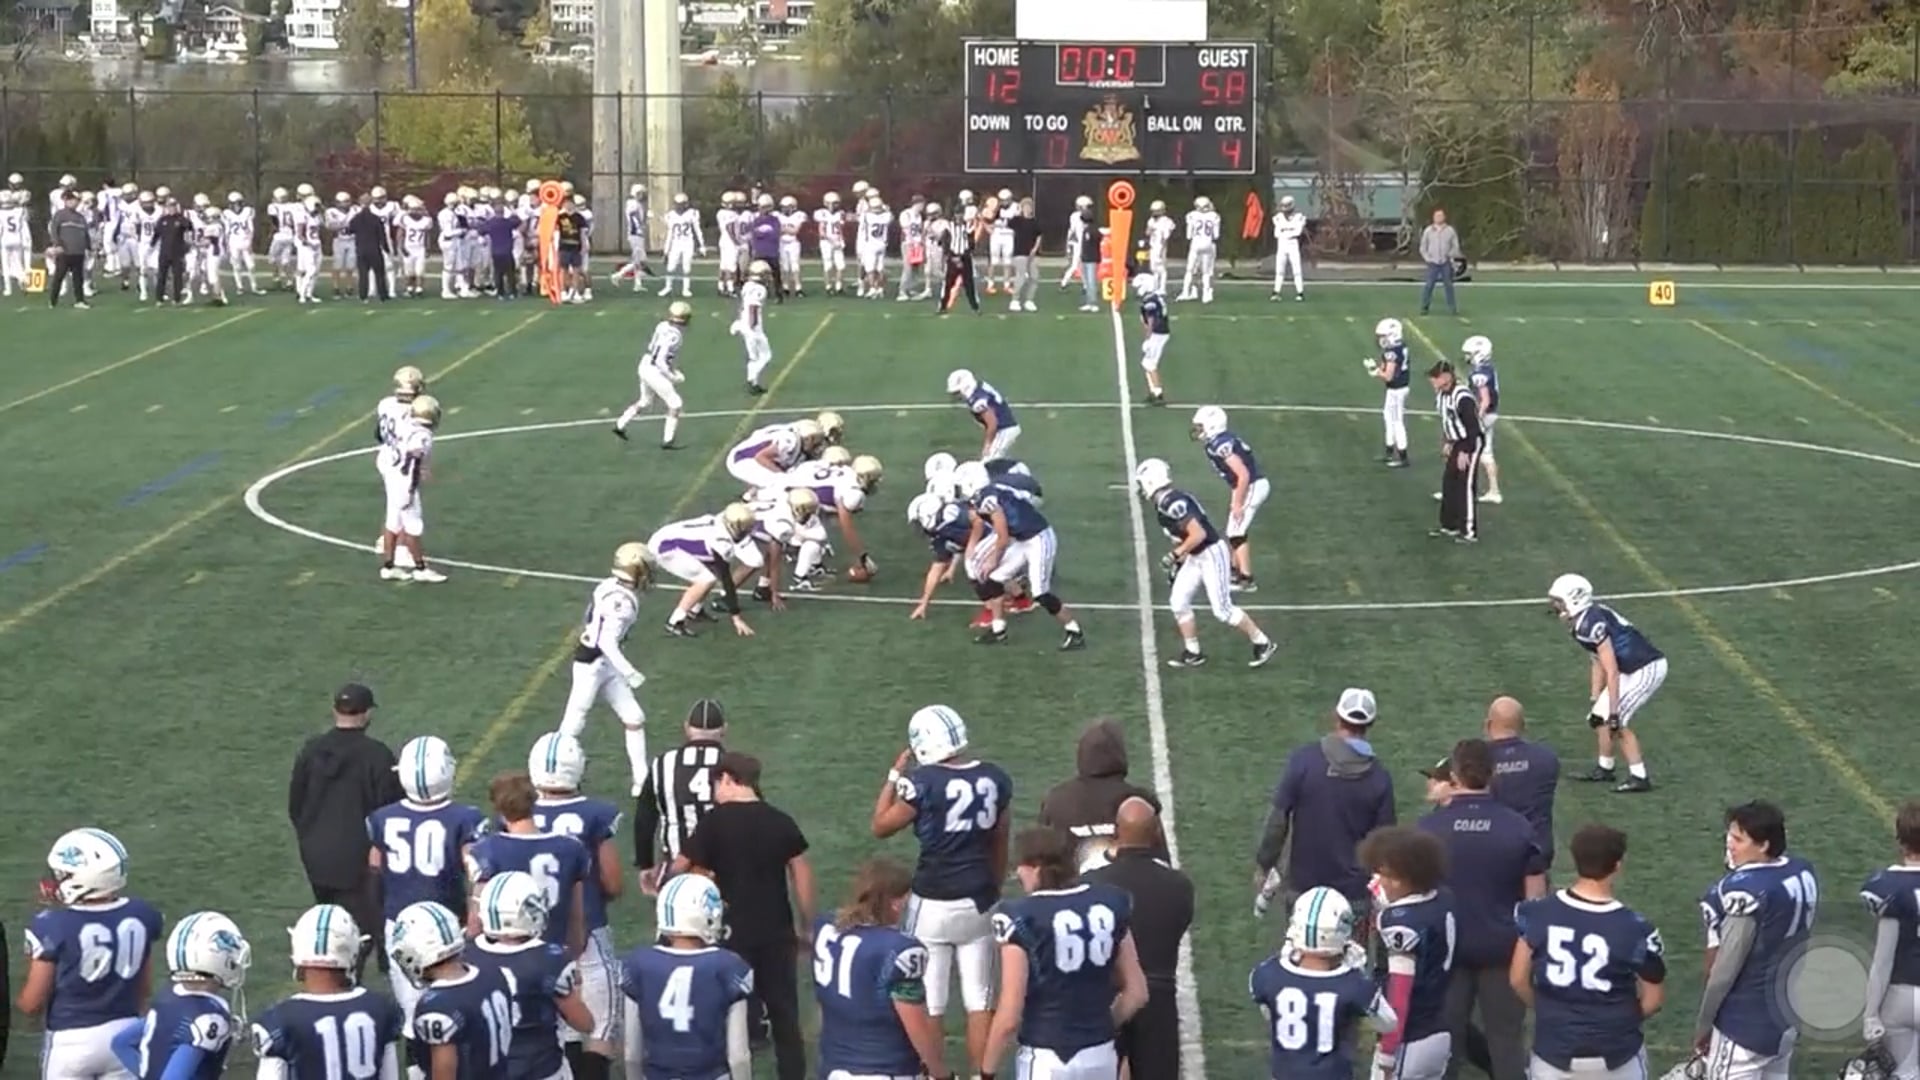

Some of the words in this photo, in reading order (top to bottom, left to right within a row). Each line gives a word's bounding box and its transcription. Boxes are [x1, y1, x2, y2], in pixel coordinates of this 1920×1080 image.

[974, 47, 1019, 66] HOME
[1198, 48, 1248, 68] GUEST
[986, 69, 1020, 104] 12
[970, 114, 1010, 131] DOWN
[1024, 115, 1044, 131] TO
[1046, 115, 1068, 131] GO
[1147, 115, 1180, 131] BALL
[1182, 115, 1202, 131] ON
[1214, 115, 1246, 132] QTR.
[1220, 138, 1243, 169] 4
[1655, 284, 1672, 300] 40
[1496, 760, 1530, 775] COACH
[688, 767, 712, 802] 4
[943, 776, 999, 833] 23
[1453, 819, 1492, 832] COACH
[383, 816, 447, 877] 50
[78, 917, 147, 983] 60
[1052, 903, 1116, 974] 68
[1394, 931, 1404, 949] 9
[813, 923, 863, 999] 51
[1545, 924, 1613, 993] 52
[658, 965, 694, 1032] 4
[205, 1021, 219, 1040] 8
[424, 1019, 443, 1040] 18
[1275, 986, 1339, 1054] 81
[314, 1012, 377, 1080] 10
